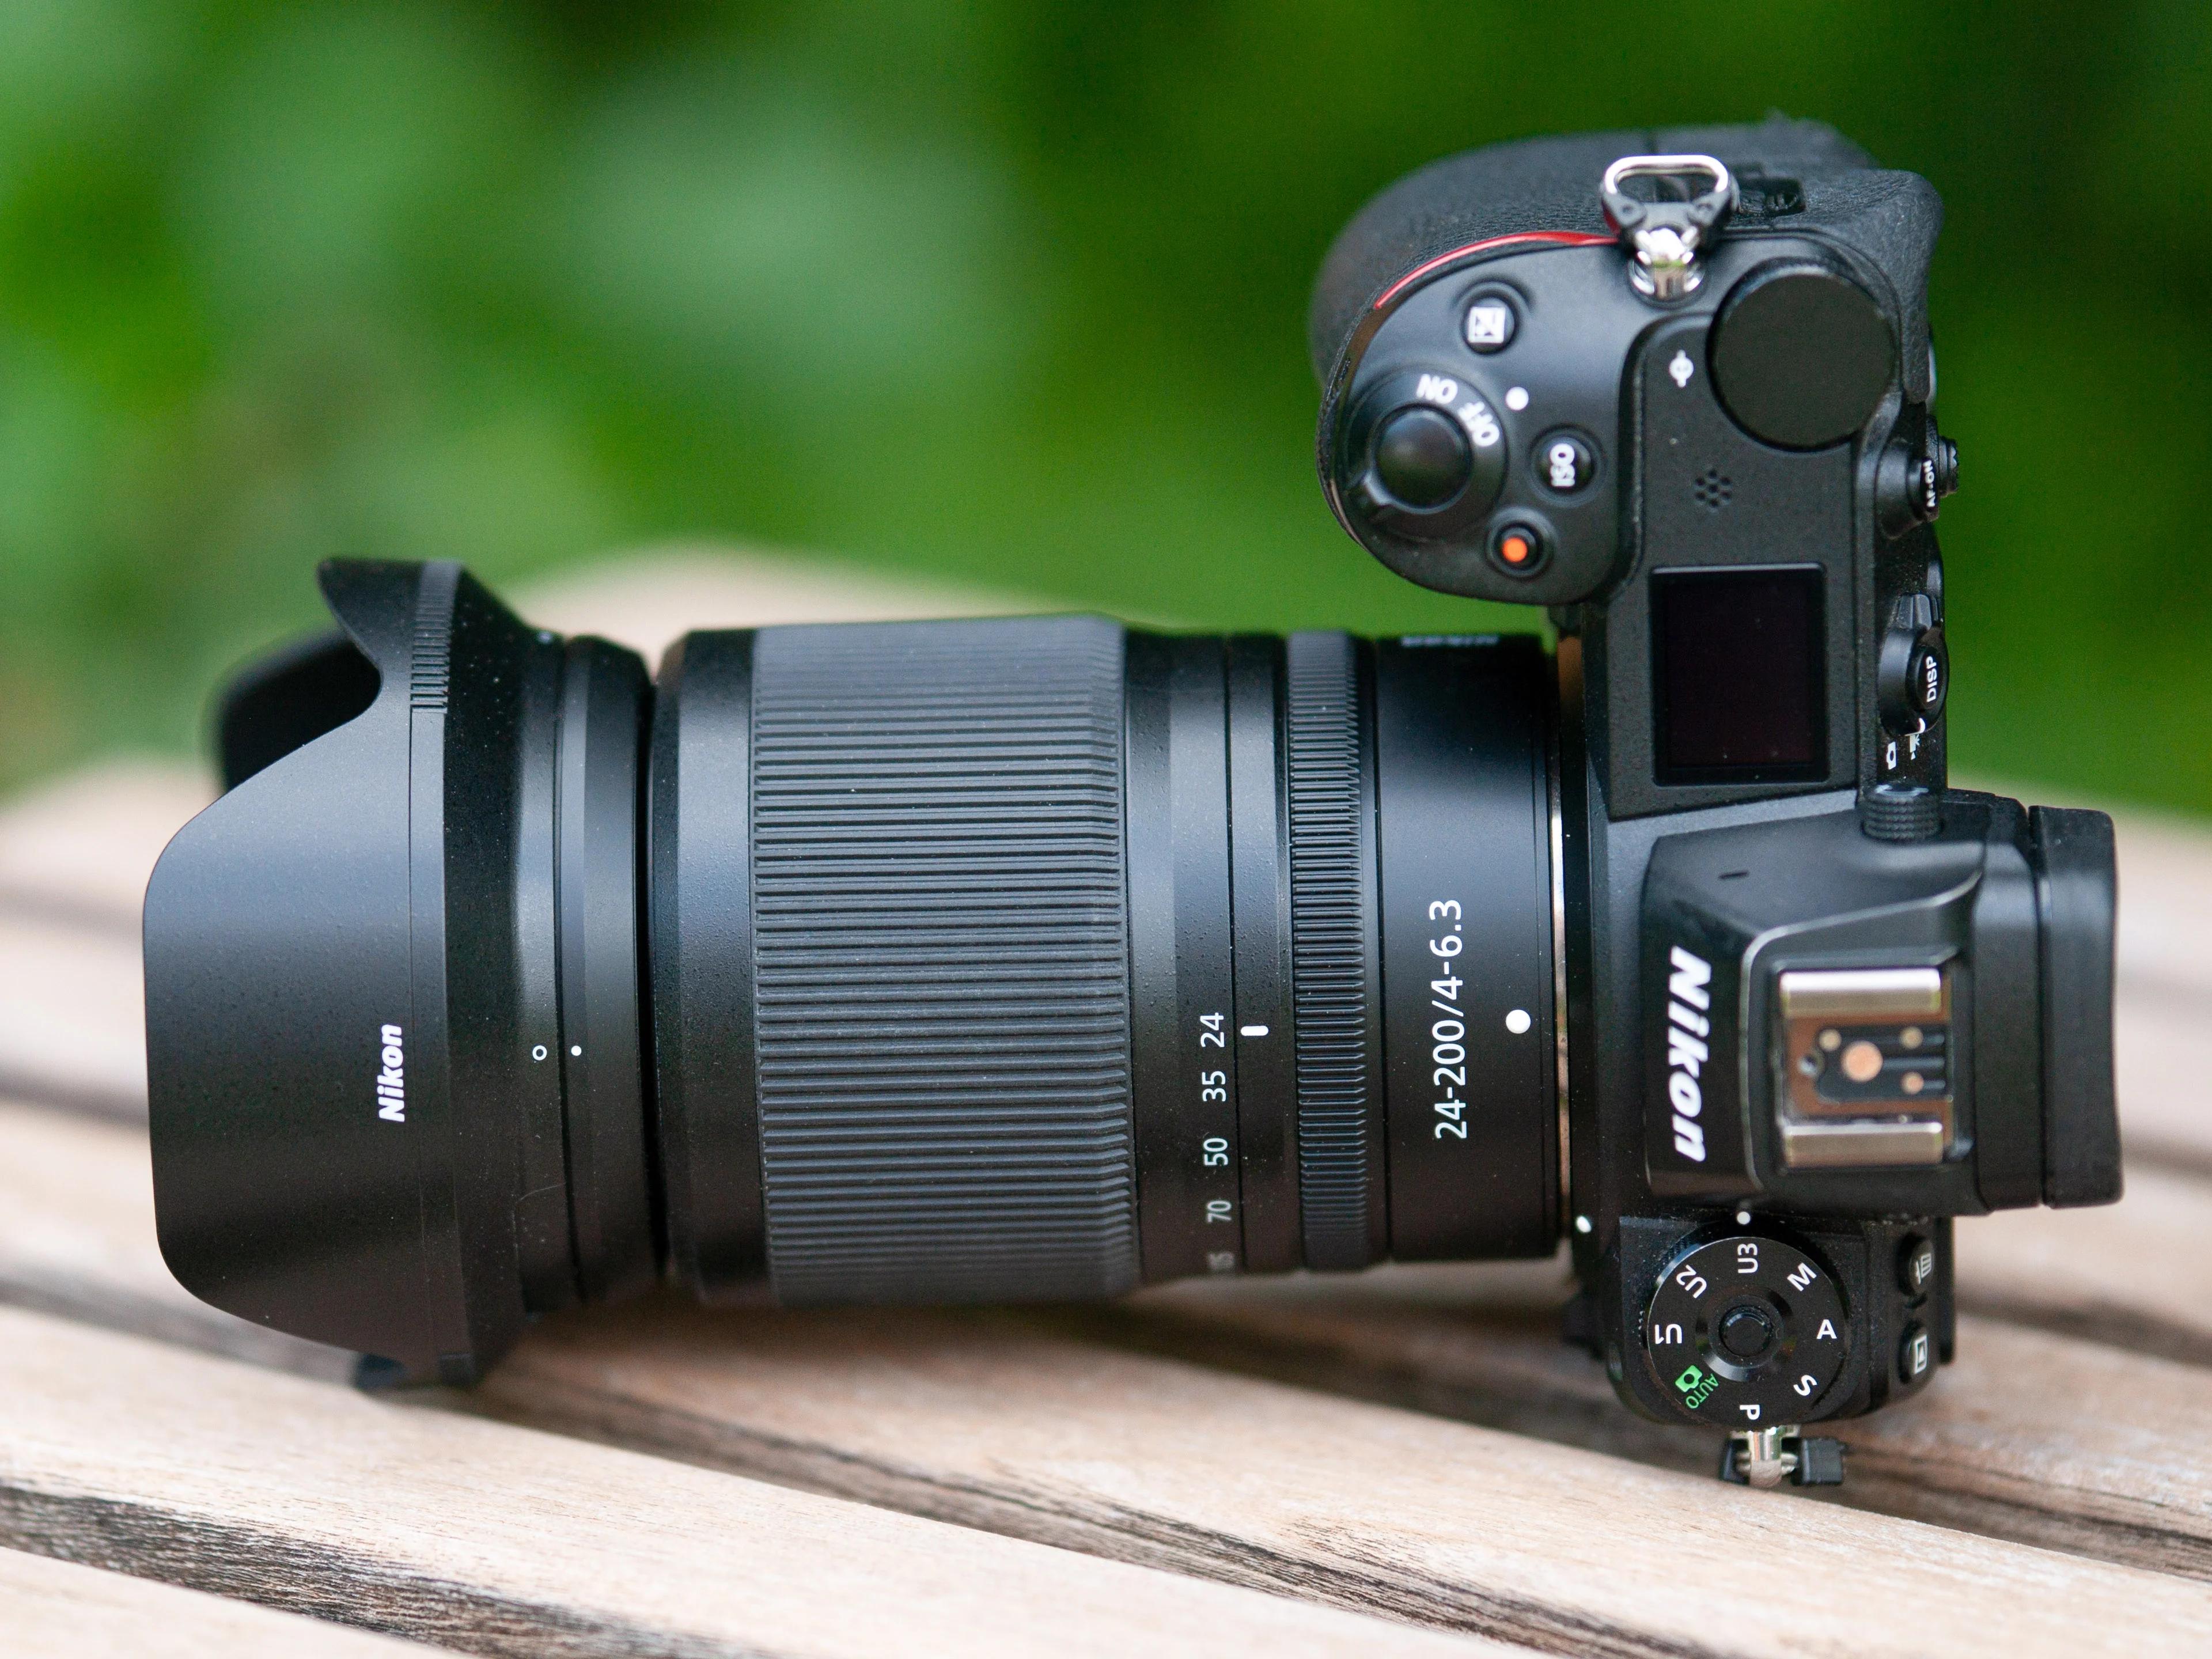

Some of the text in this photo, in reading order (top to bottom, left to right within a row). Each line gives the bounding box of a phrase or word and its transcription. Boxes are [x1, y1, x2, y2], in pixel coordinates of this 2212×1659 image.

[1416, 374, 1459, 404] ON
[1457, 401, 1500, 447] OFF
[1550, 442, 1575, 487] ISO
[1923, 460, 1936, 507] AF-ON
[1926, 656, 1938, 703] DISP
[1199, 1012, 1225, 1048] 24
[1428, 899, 1468, 1139] 24-200/4-6.3
[1668, 945, 1711, 1162] Nikon
[377, 1024, 405, 1122] Nikon
[1202, 1071, 1226, 1102] 35
[1203, 1137, 1229, 1166] 50
[1206, 1200, 1232, 1223] 70
[1737, 1243, 1759, 1274] U3
[1675, 1264, 1707, 1299] U2
[1787, 1262, 1817, 1291] M
[1654, 1323, 1683, 1344] U1
[1816, 1319, 1838, 1340] A
[1685, 1373, 1719, 1409] AUTO
[1793, 1374, 1818, 1397] S
[1739, 1404, 1761, 1421] P
